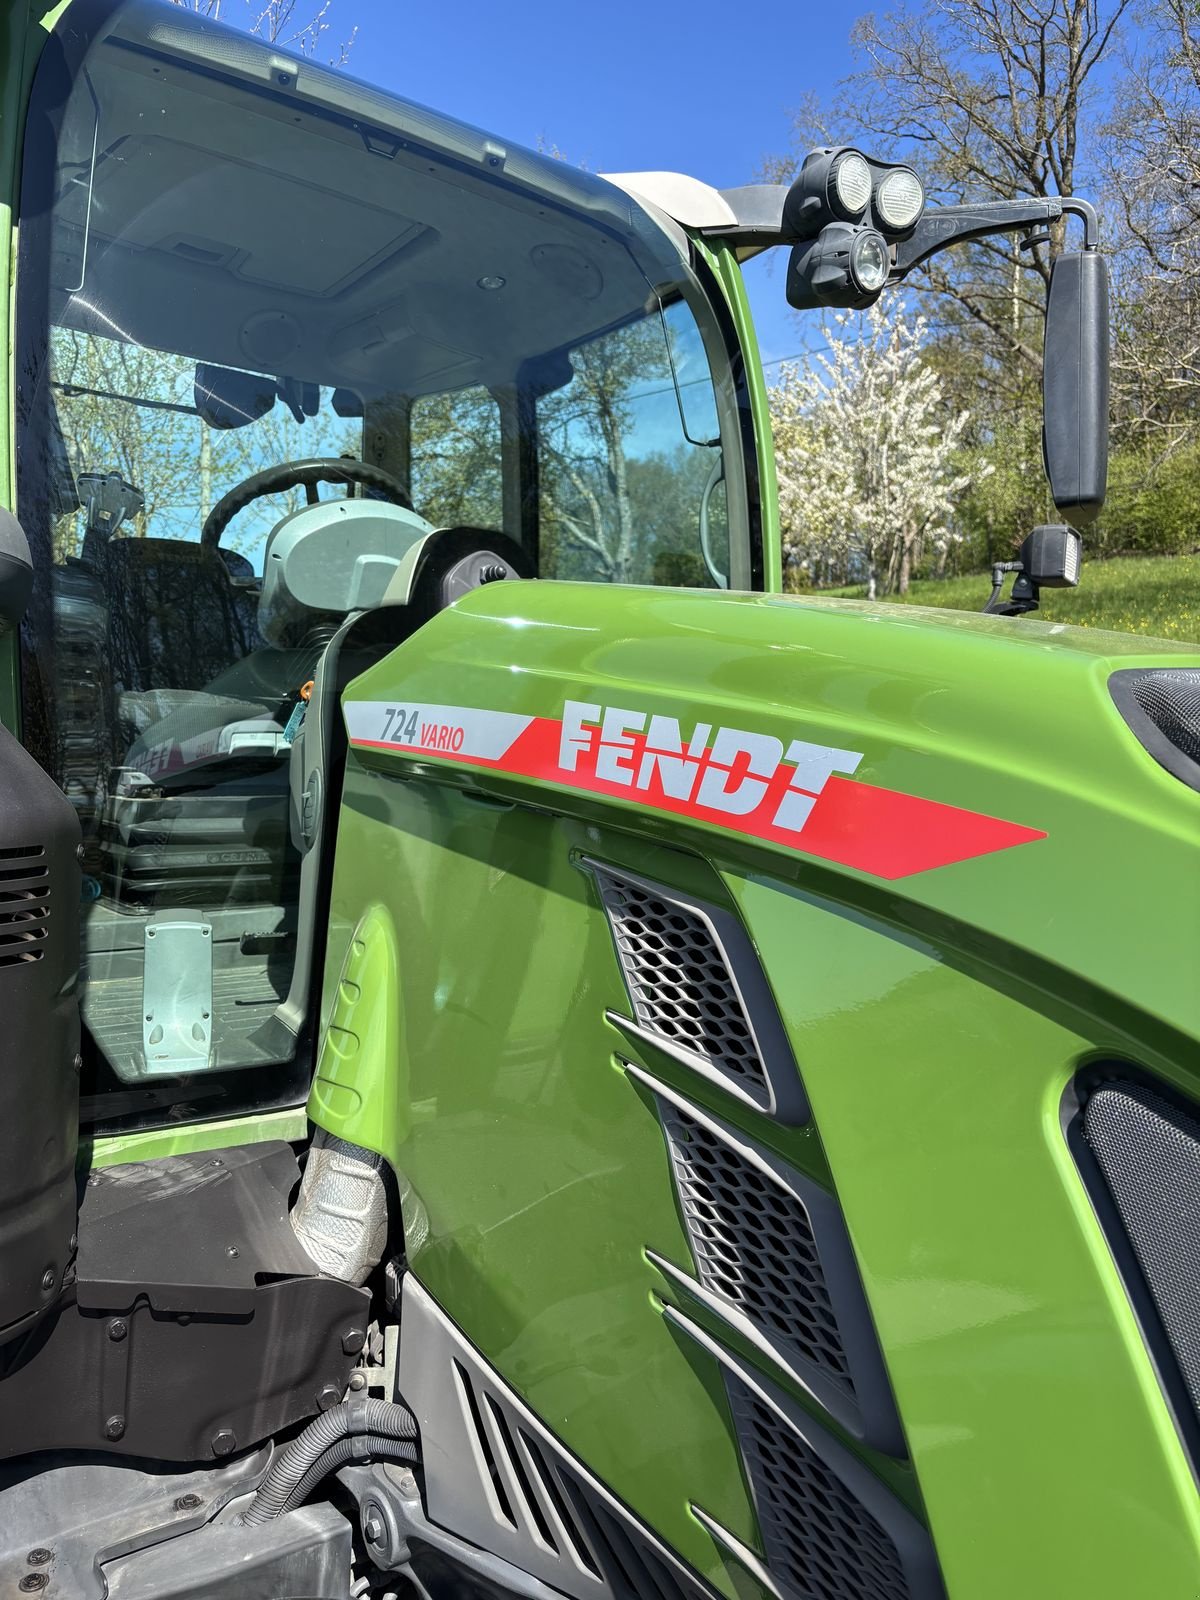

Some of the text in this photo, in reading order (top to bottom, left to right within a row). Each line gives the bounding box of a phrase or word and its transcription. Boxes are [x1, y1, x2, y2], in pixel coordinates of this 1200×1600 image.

[381, 709, 464, 753] 724 VARIO
[558, 700, 864, 832] FENDT
